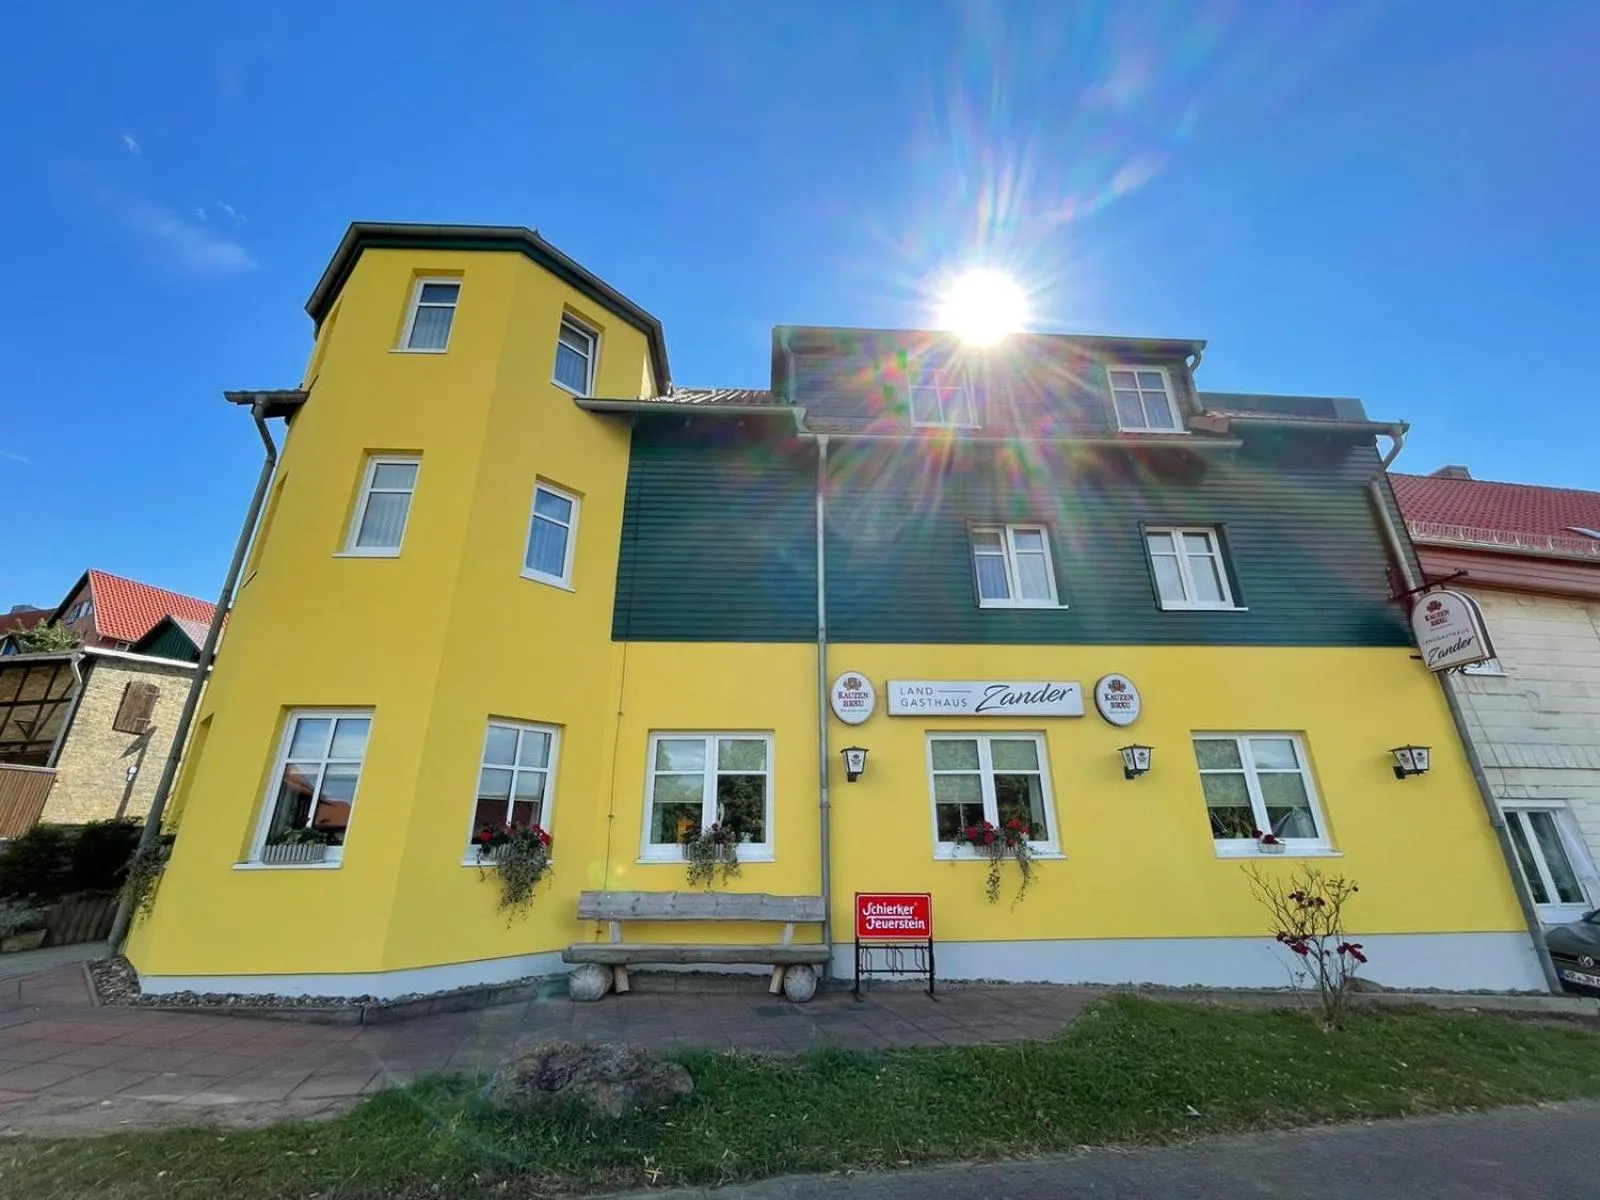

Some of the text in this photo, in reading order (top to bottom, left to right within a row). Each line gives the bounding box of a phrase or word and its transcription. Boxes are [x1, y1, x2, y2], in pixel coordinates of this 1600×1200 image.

[1428, 636, 1475, 667] Zander
[838, 691, 868, 699] KAUZEN
[900, 687, 934, 695] LAND
[900, 698, 968, 707] GASTHAUS
[975, 683, 1073, 713] Zander
[1104, 693, 1134, 701] KAUZEN
[862, 902, 915, 915] Schierker
[866, 916, 926, 929] Feuerstein
